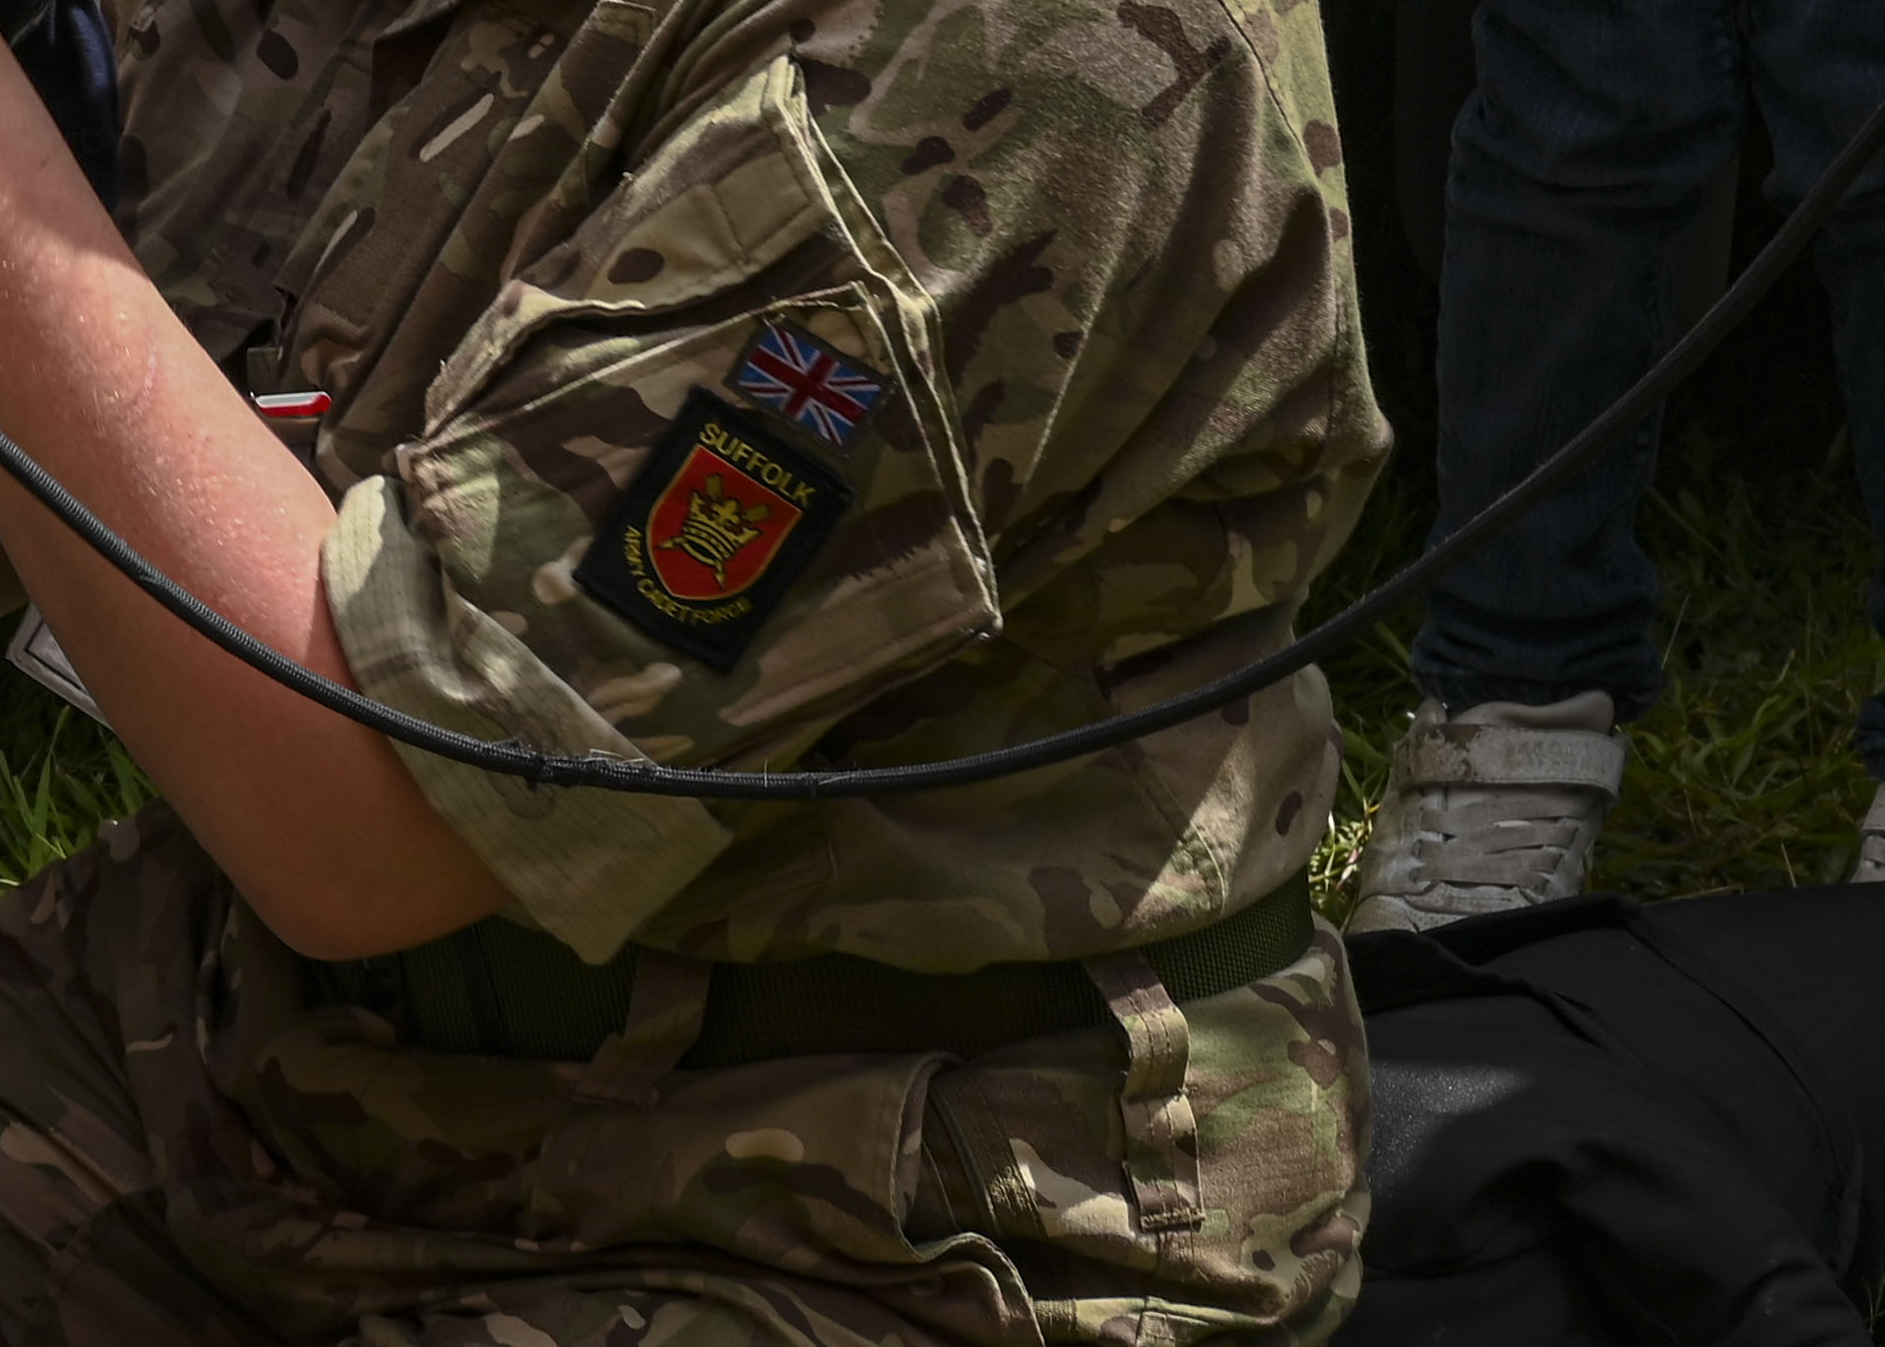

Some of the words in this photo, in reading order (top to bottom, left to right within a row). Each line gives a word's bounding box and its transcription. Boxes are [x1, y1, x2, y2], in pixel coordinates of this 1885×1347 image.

[699, 423, 815, 504] SUFFOLK
[623, 525, 647, 577] ARMY
[637, 578, 691, 622] CADET
